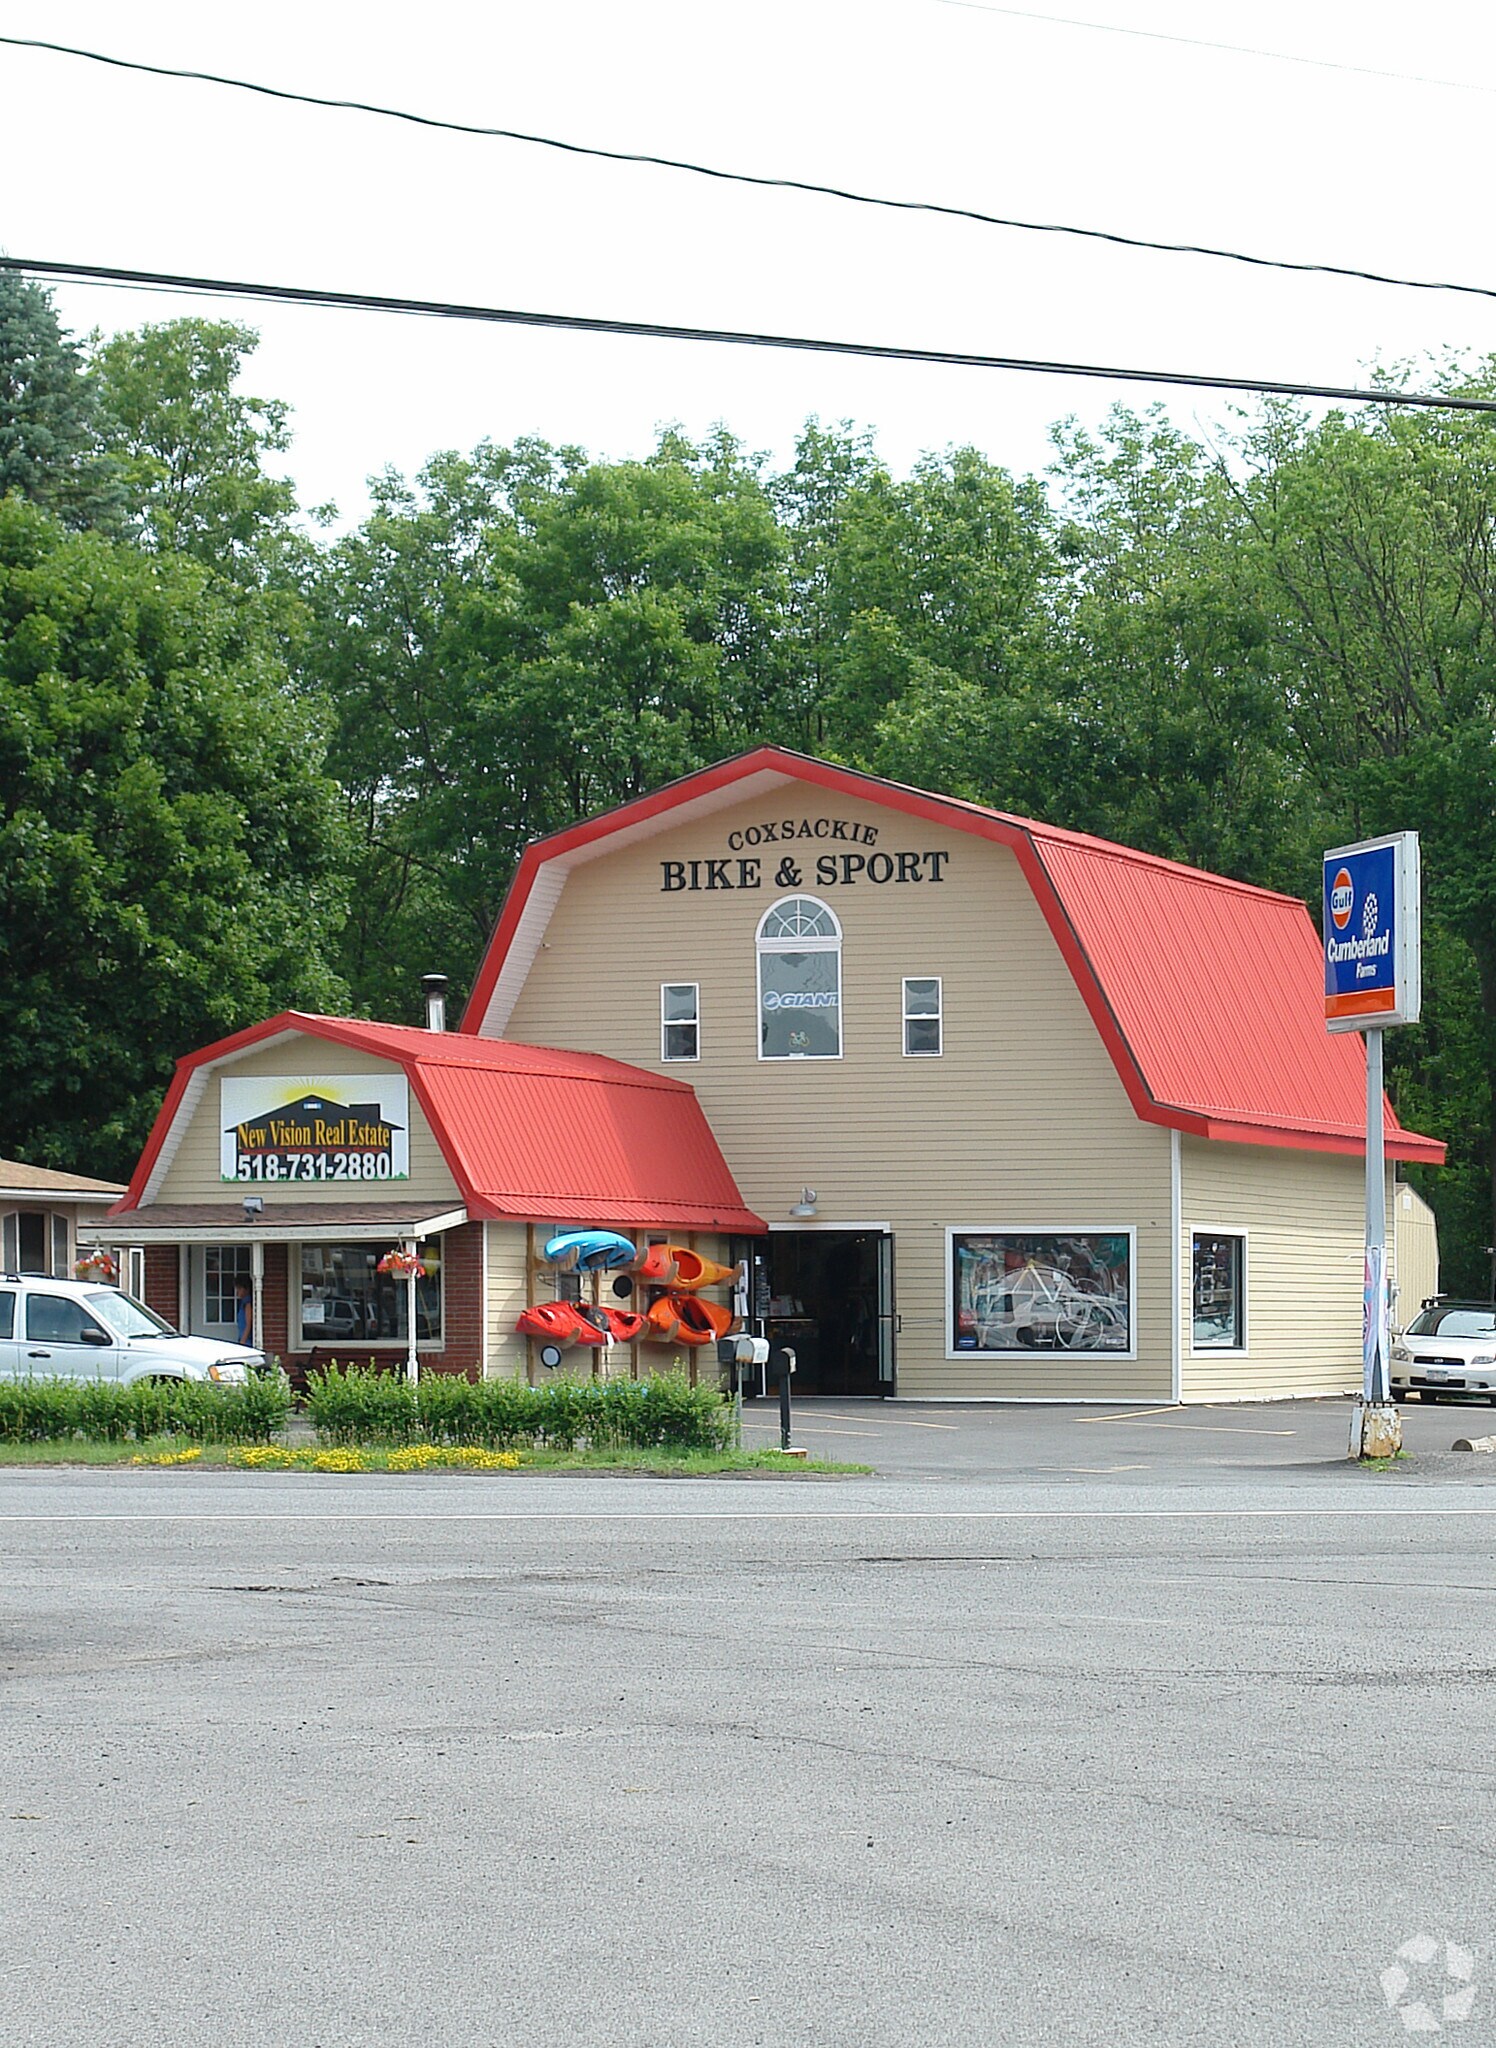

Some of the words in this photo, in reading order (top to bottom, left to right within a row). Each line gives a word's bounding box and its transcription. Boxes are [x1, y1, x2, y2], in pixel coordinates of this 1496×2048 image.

[728, 818, 879, 851] COXSACKIE
[660, 858, 762, 892] BIKE
[775, 856, 803, 888] &
[816, 851, 950, 886] SPORT
[1332, 891, 1352, 909] Gulf
[1327, 929, 1390, 963] Cumberland
[1356, 962, 1377, 979] Farms
[780, 992, 839, 1008] GIANT
[237, 1123, 268, 1149] New
[269, 1119, 312, 1146] Vision
[314, 1119, 345, 1146] Real
[348, 1119, 390, 1147] Estate
[237, 1152, 391, 1181] 518-731-2880
